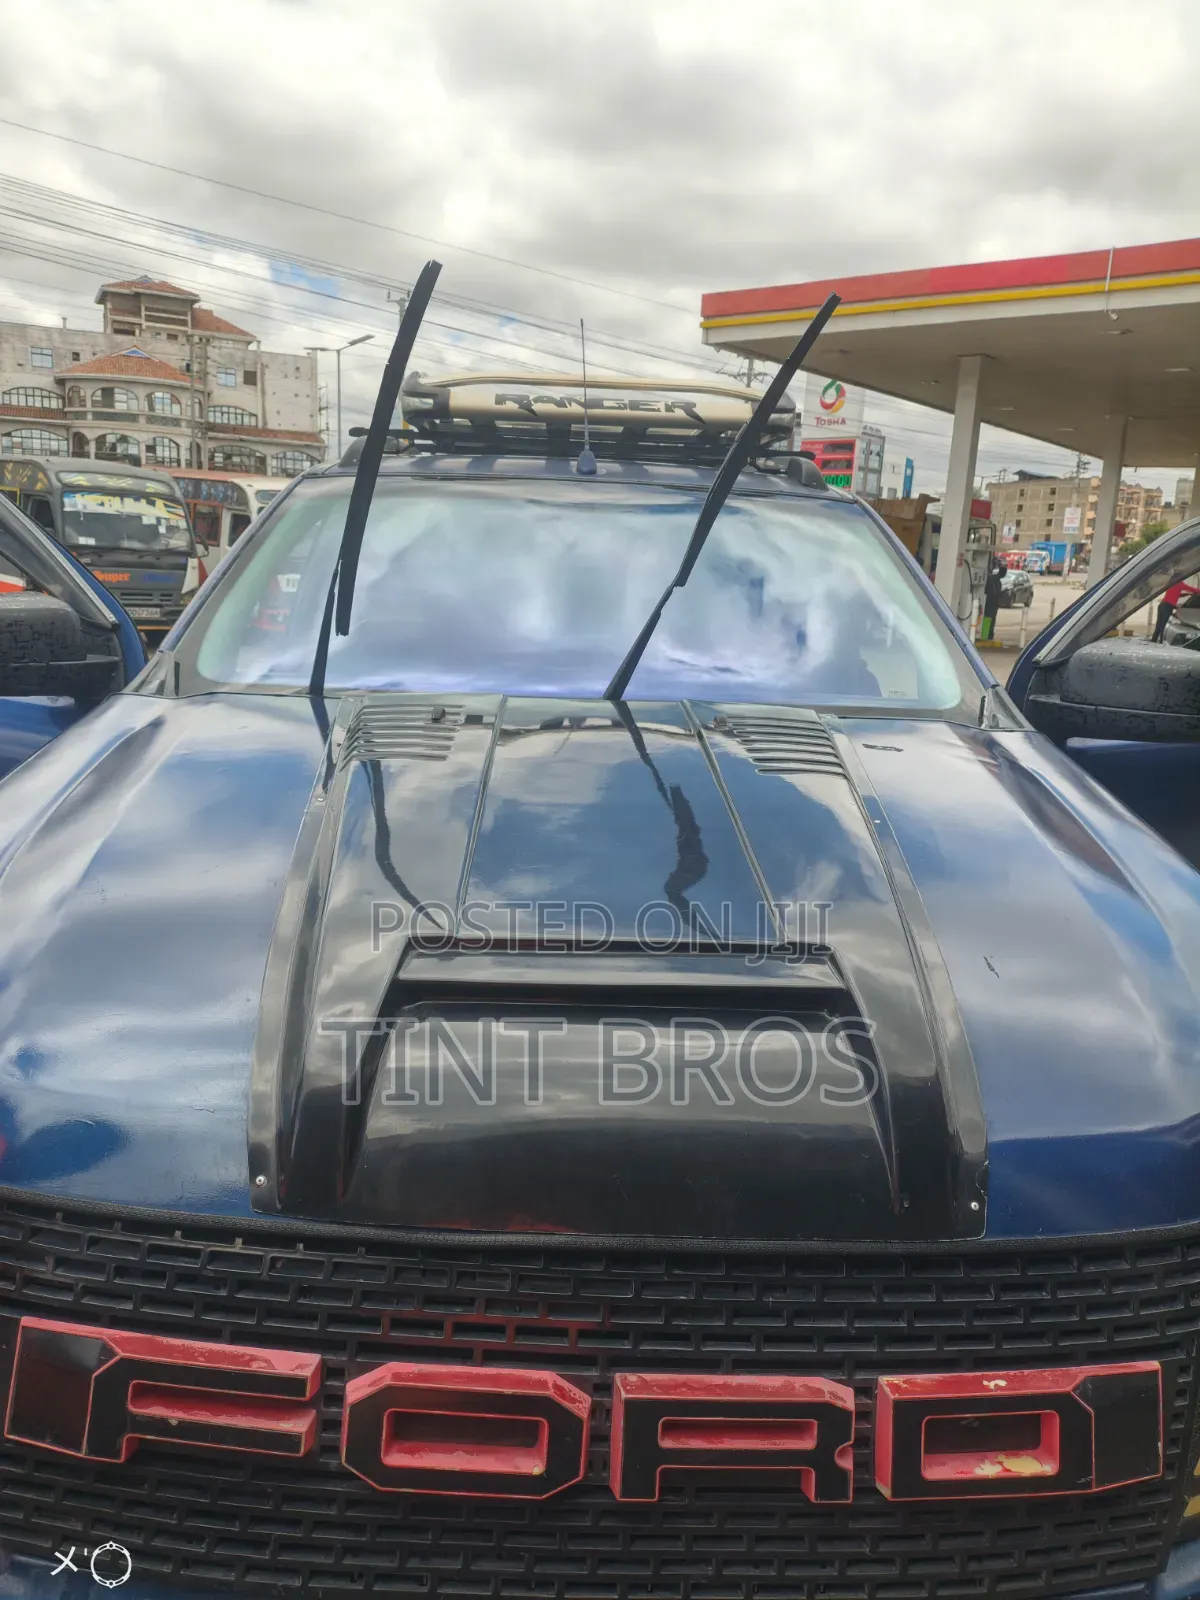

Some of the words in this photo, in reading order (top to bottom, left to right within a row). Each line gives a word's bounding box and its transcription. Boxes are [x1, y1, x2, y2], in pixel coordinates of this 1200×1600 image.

[494, 393, 706, 424] RANGER
[814, 416, 847, 426] TOSHA
[4, 1316, 1163, 1504] FORD
